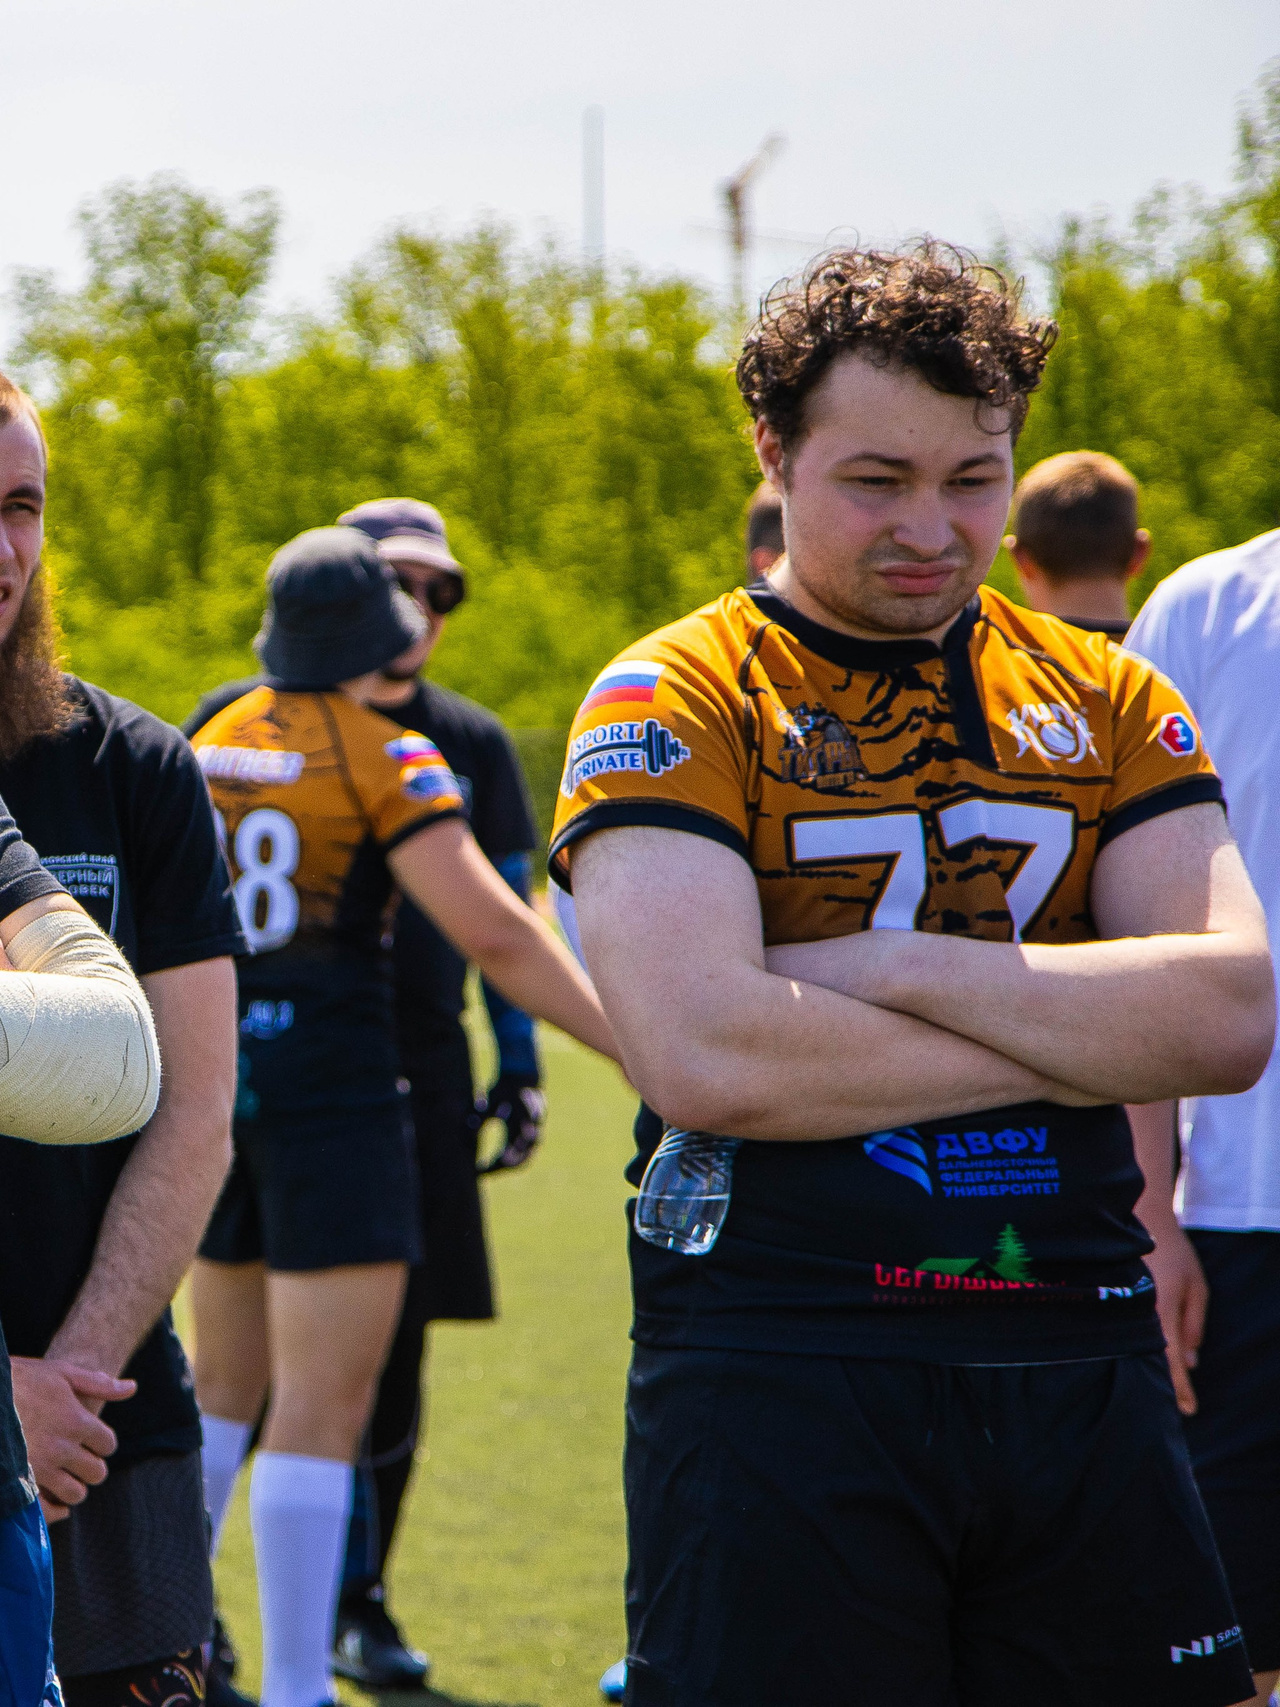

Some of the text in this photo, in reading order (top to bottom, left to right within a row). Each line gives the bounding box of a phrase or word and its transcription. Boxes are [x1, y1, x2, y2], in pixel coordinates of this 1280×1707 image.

[574, 723, 640, 754] SPORT
[574, 752, 641, 783] PRIVATE
[793, 799, 1075, 943] 77
[67, 884, 110, 898] ОВЕК
[934, 1126, 1048, 1158] ДВФУ
[938, 1157, 1057, 1170] ДАЛЬНЕВОСТОЧНЫЙ
[940, 1167, 1059, 1183] ФЕДЕРАЛЬНЫЙ
[942, 1182, 1060, 1197] УНИВЕРСИТЕТ
